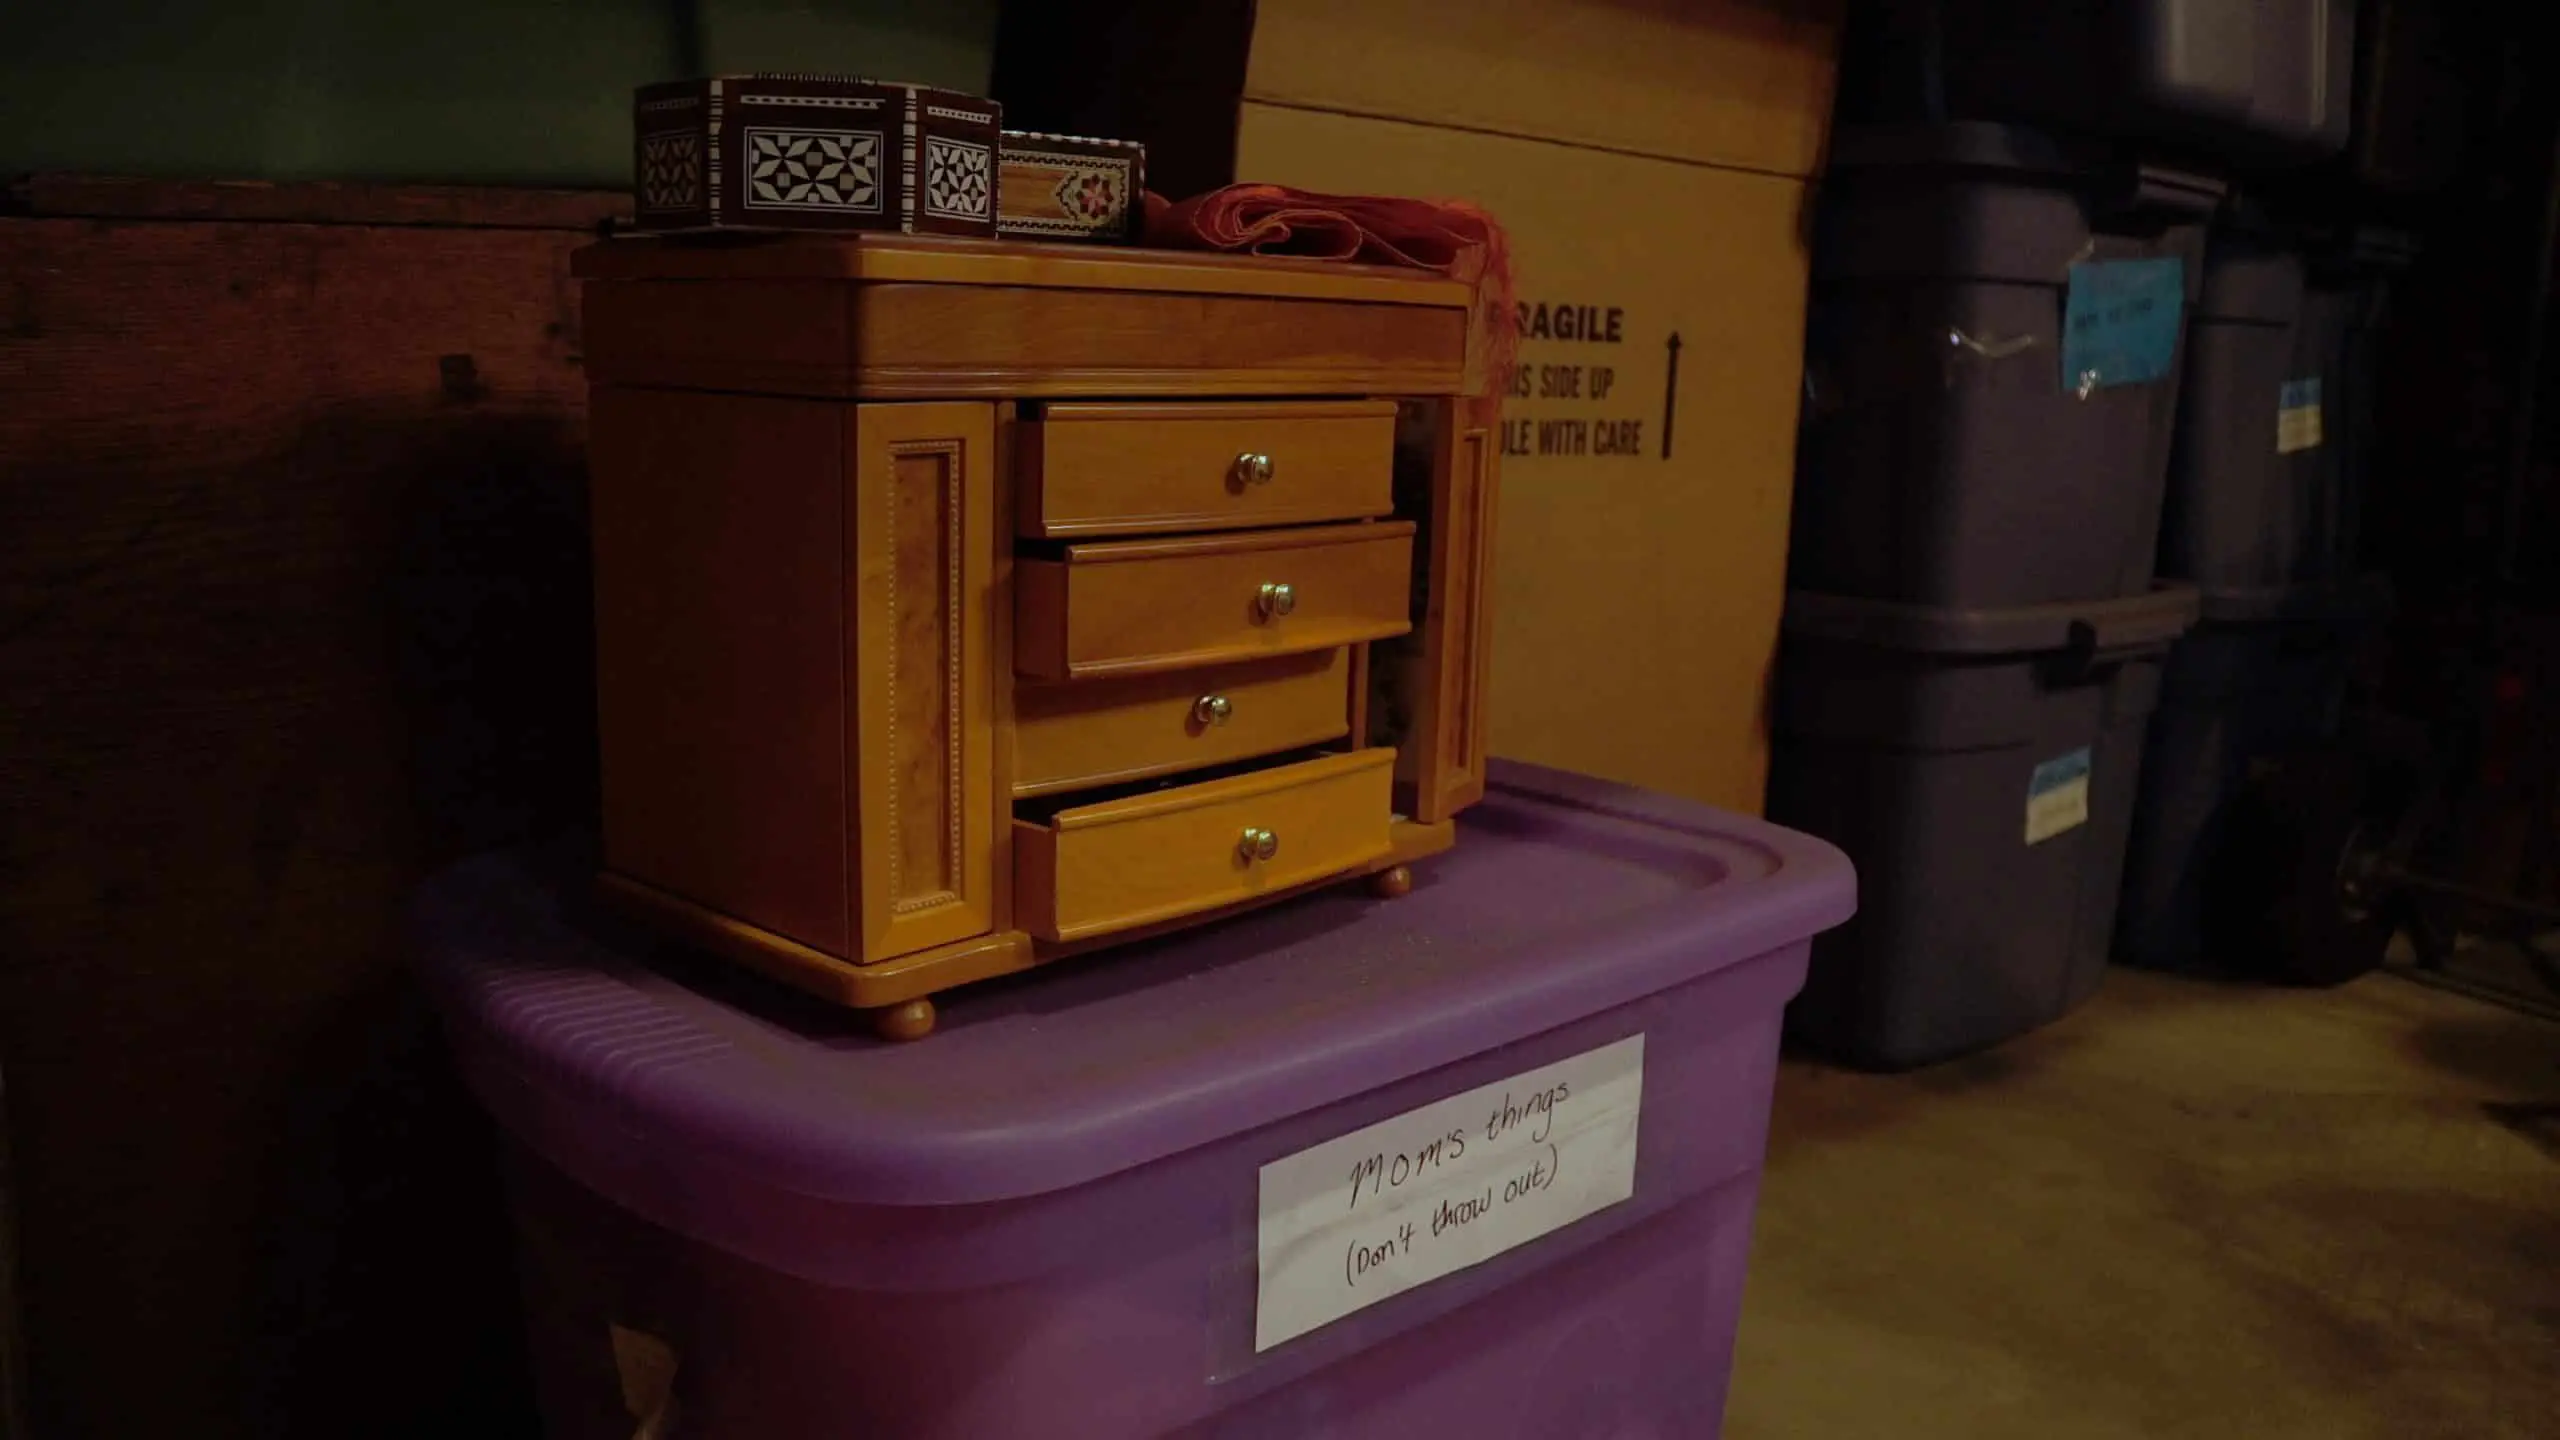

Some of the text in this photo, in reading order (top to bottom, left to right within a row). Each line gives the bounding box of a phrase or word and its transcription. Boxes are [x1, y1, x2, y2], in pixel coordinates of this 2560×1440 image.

[1540, 364, 1582, 399] SIDE
[1590, 366, 1615, 400] UP
[1538, 419, 1587, 456] WITH
[1595, 418, 1643, 456] CARE
[1487, 1081, 1569, 1143] things
[1432, 1188, 1492, 1238] throw
[1504, 1143, 1558, 1203] out)
